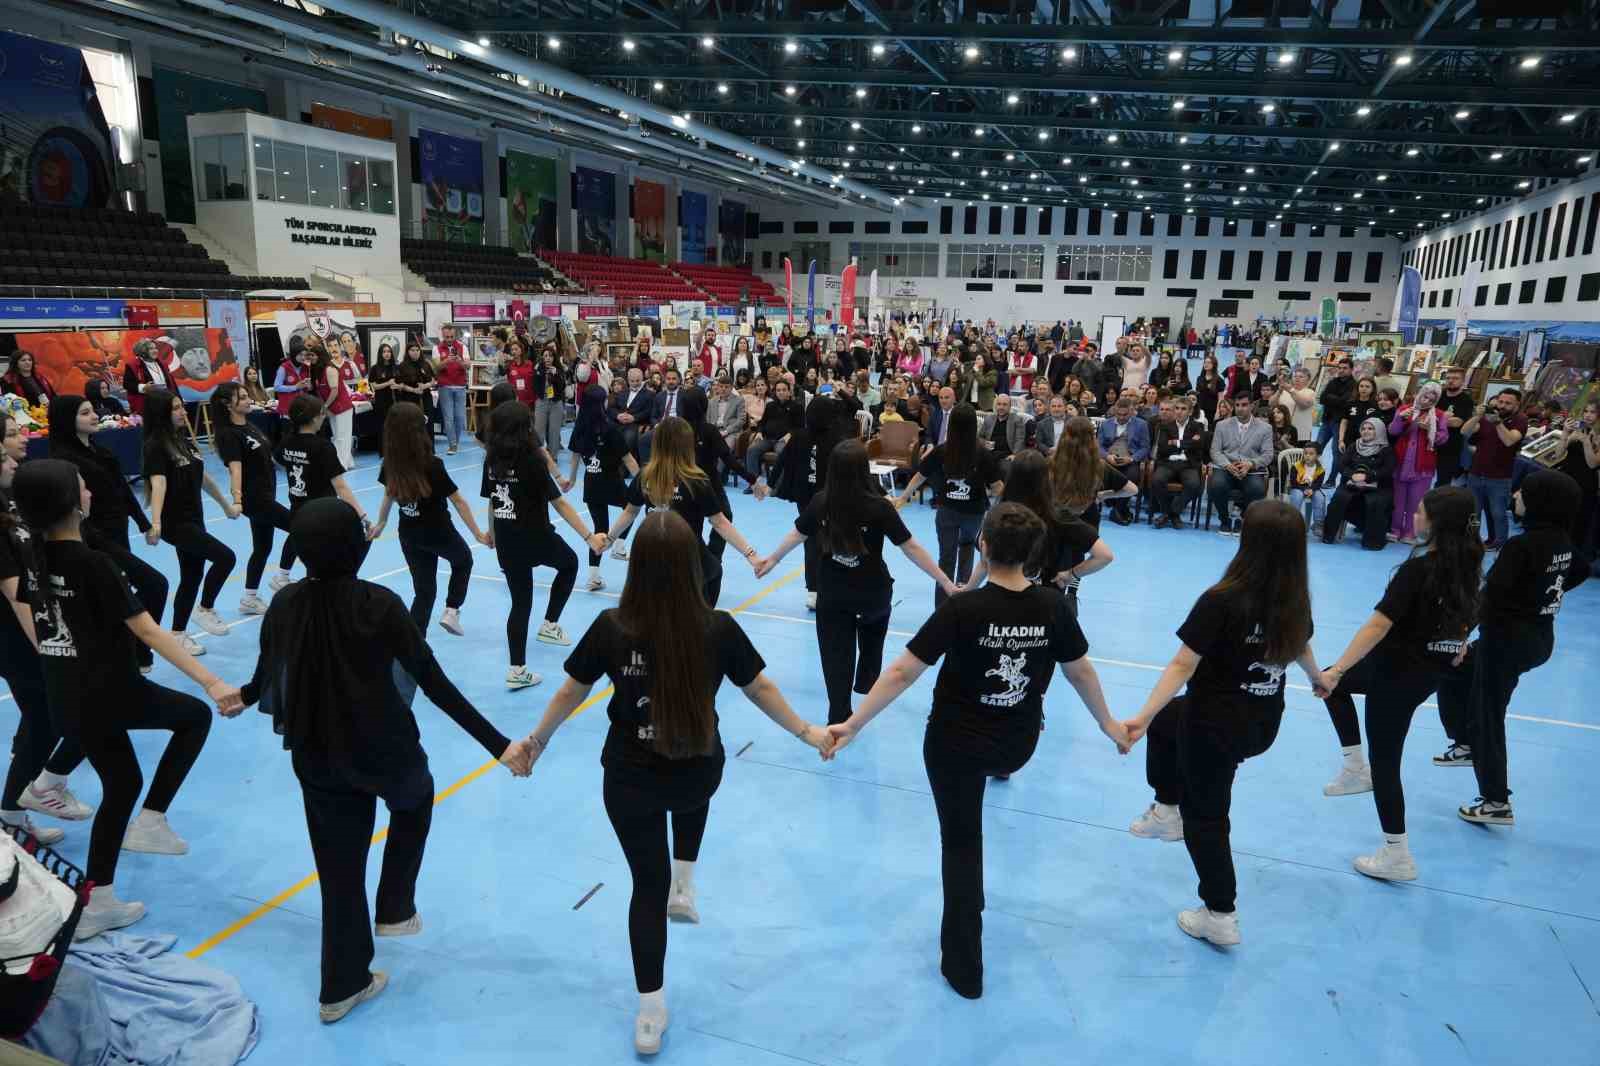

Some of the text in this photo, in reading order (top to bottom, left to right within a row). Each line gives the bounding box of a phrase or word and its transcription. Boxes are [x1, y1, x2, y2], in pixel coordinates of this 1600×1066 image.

[284, 217, 305, 229] TÜM
[291, 233, 341, 246] BAŞARILAR
[988, 623, 1046, 637] İLKADIM
